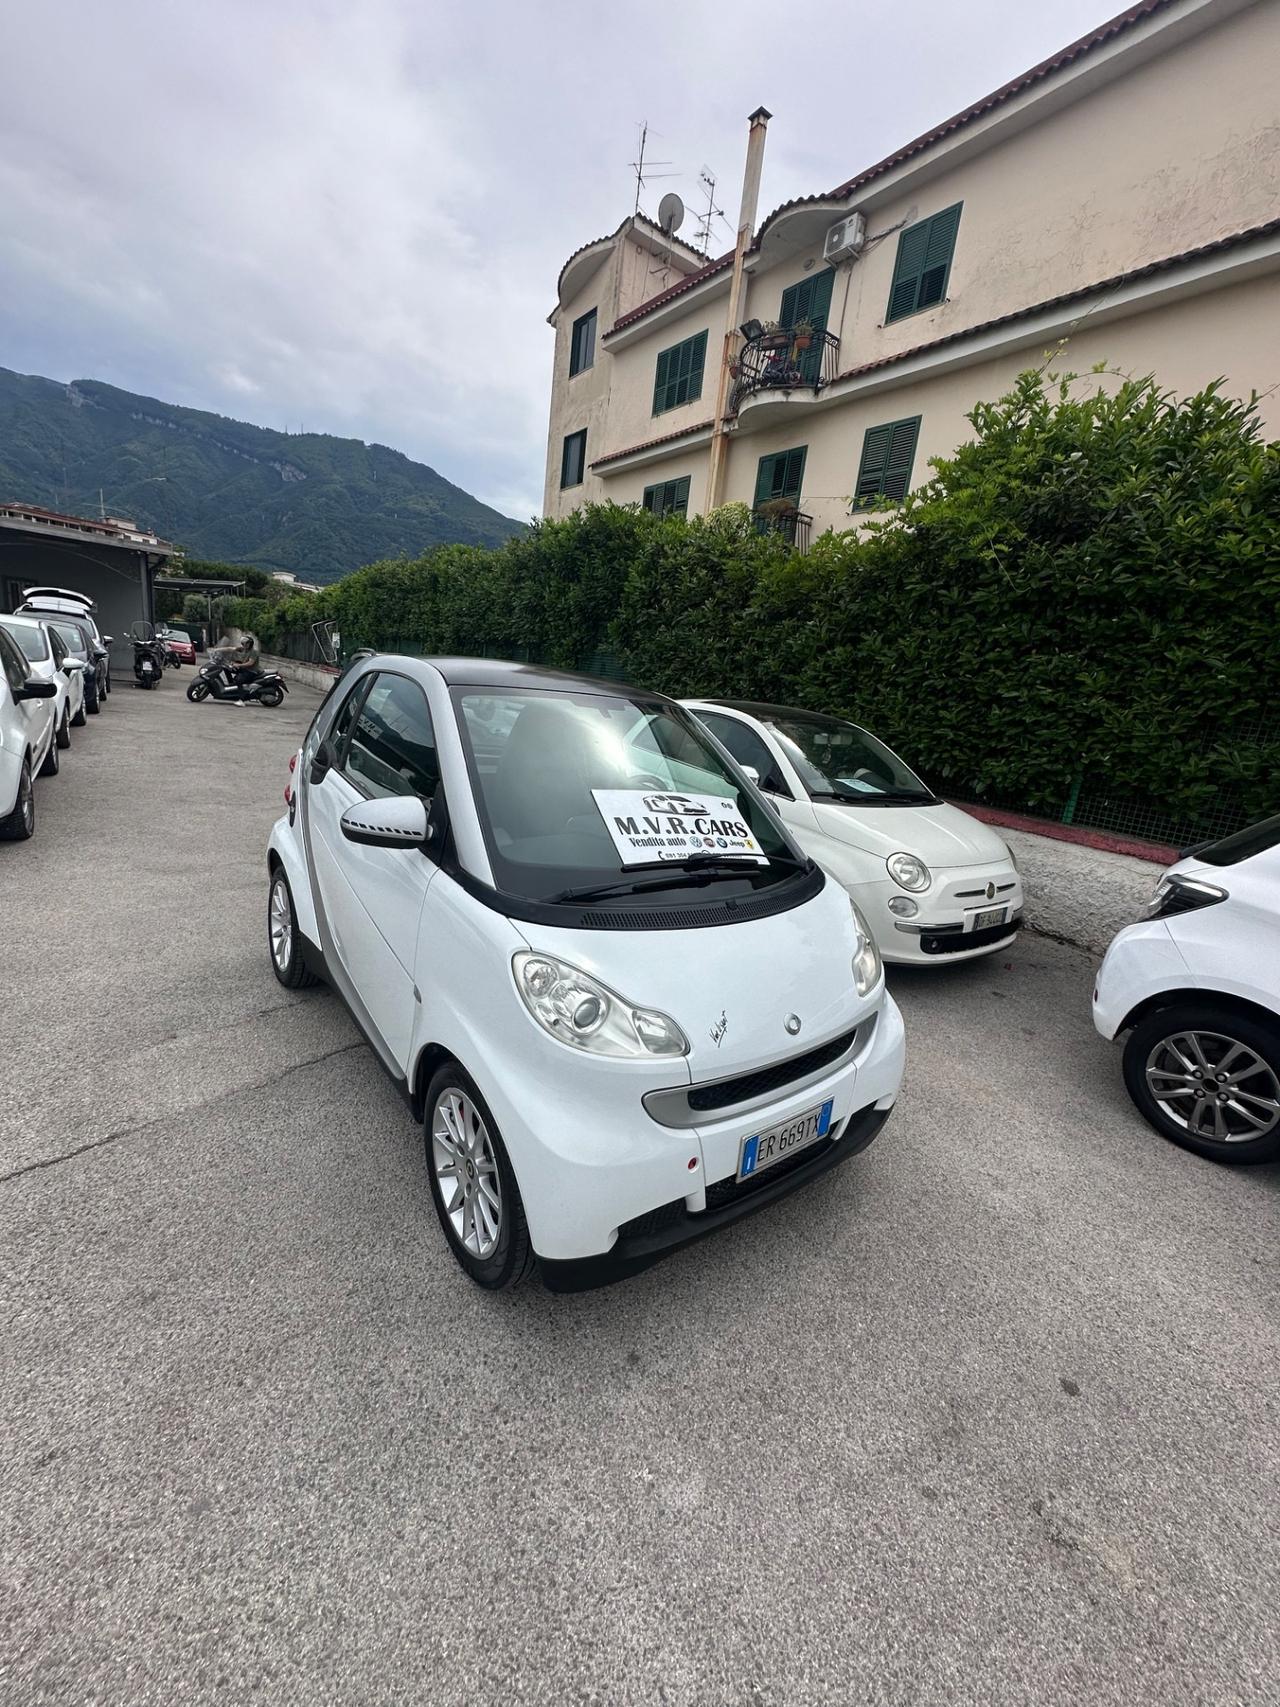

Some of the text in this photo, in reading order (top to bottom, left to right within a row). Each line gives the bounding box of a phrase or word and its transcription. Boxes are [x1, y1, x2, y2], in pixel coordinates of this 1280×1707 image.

[629, 837, 687, 847] Vendita auto
[729, 839, 745, 848] Jeep
